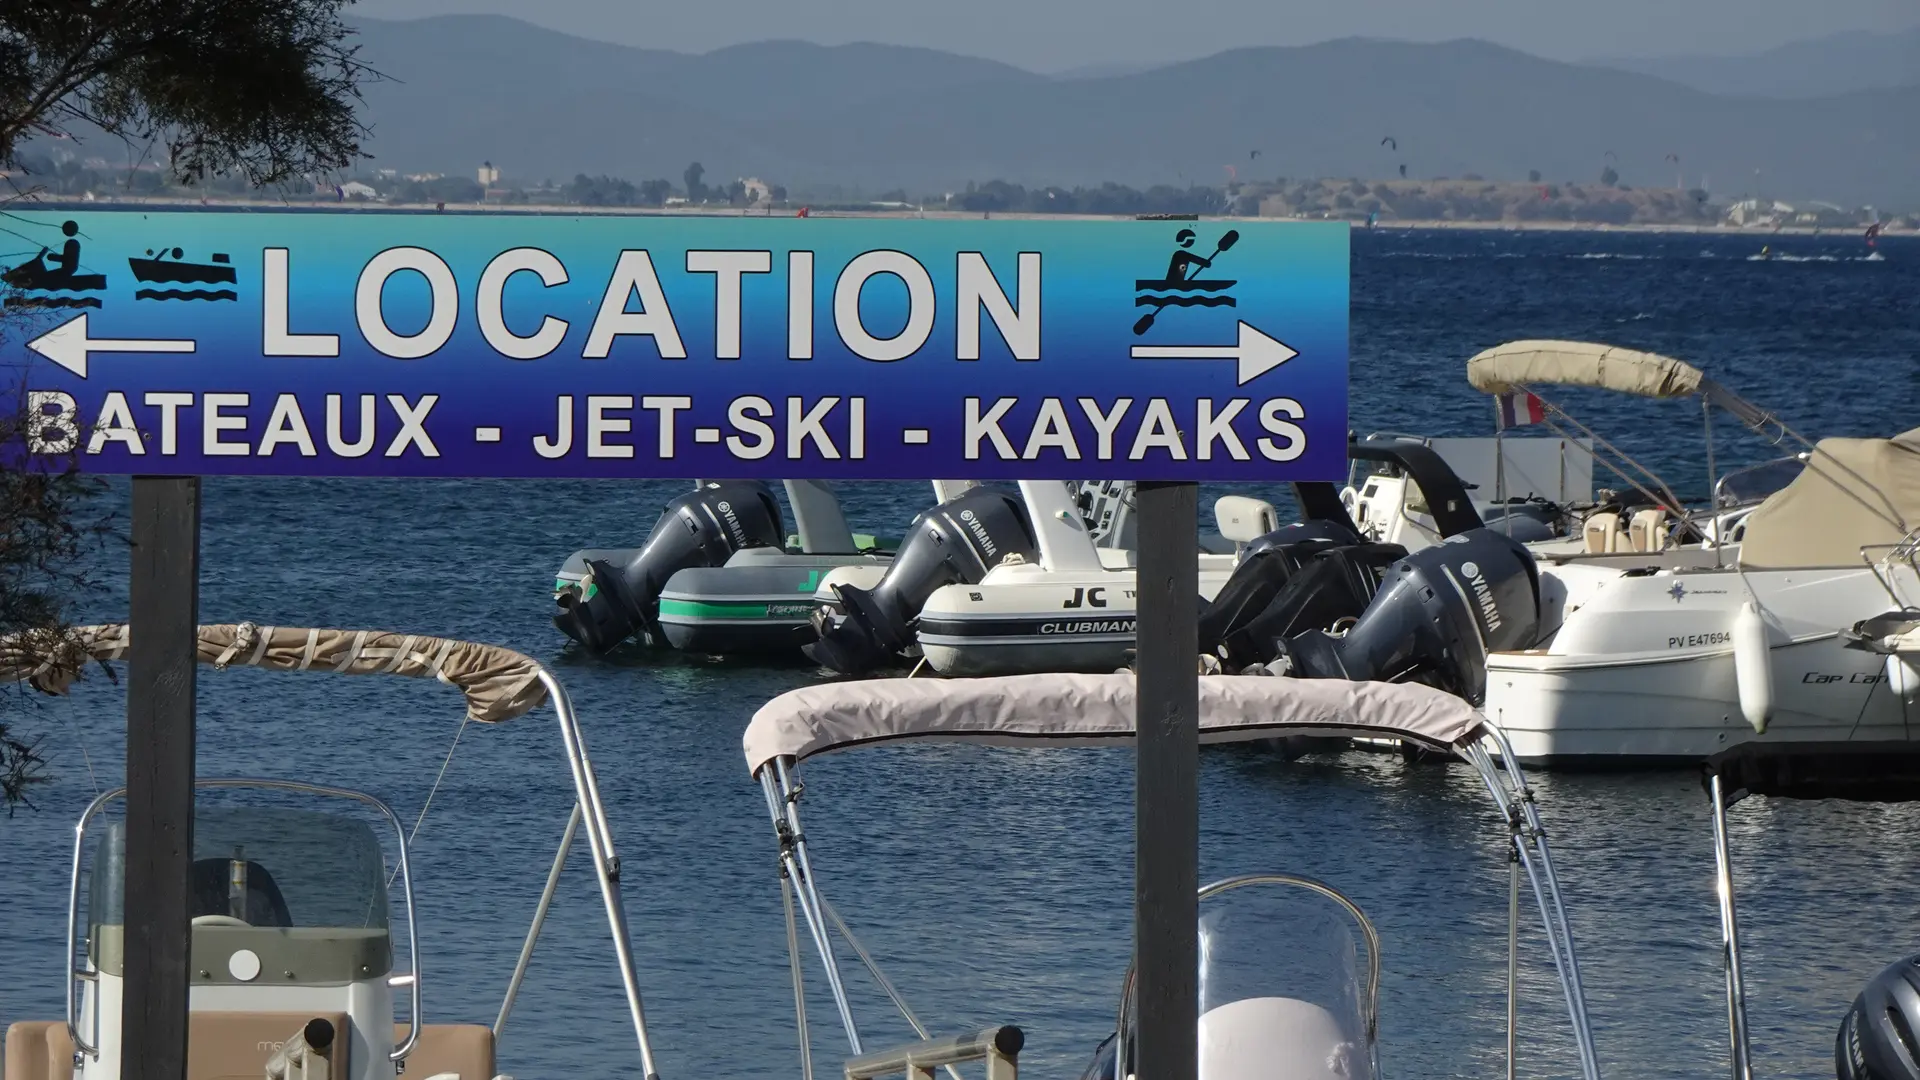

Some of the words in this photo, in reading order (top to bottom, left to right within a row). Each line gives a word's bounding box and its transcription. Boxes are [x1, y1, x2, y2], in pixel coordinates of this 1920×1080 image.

[263, 246, 1041, 361] LOCATION
[27, 390, 441, 458] BATEAUX
[532, 395, 865, 460] JET-SKI
[964, 397, 1308, 462] KAYAKS
[968, 517, 997, 557] YAMAHA
[1063, 587, 1107, 608] JC
[1470, 574, 1502, 632] YAMAHA
[1669, 636, 1685, 648] PV
[1688, 632, 1731, 647] E47694
